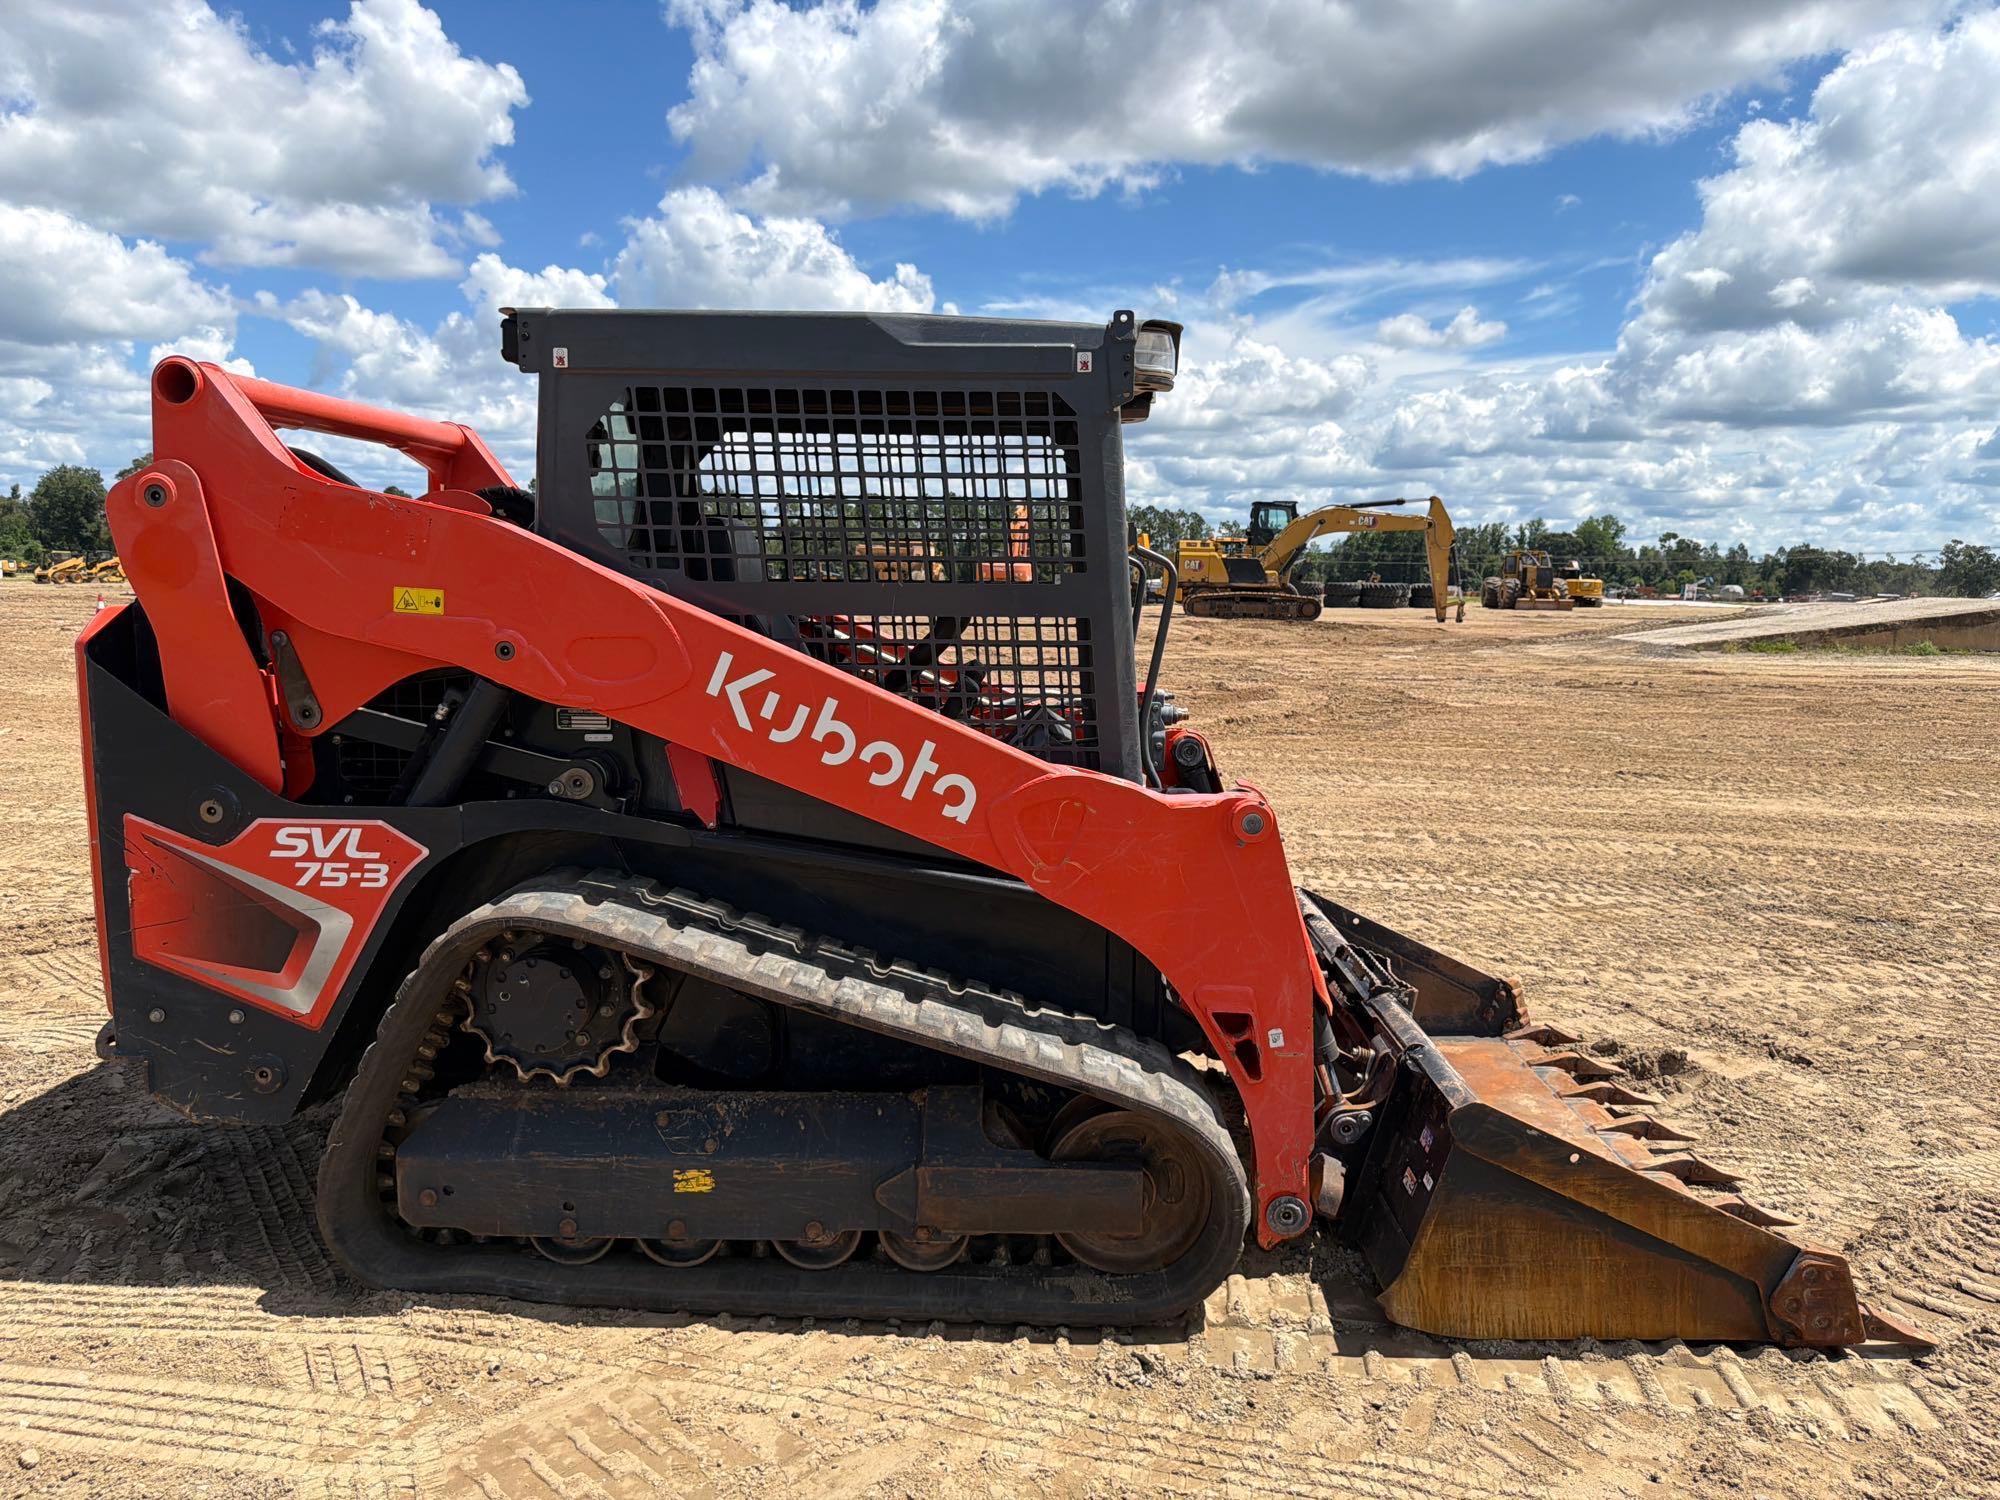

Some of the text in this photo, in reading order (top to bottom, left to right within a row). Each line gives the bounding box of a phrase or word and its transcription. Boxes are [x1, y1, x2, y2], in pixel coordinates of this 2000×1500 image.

[1358, 515, 1375, 526] CAT
[1184, 560, 1201, 570] CAT
[705, 651, 977, 825] Kubota
[269, 826, 381, 859] SVL
[294, 862, 390, 888] 75-3
